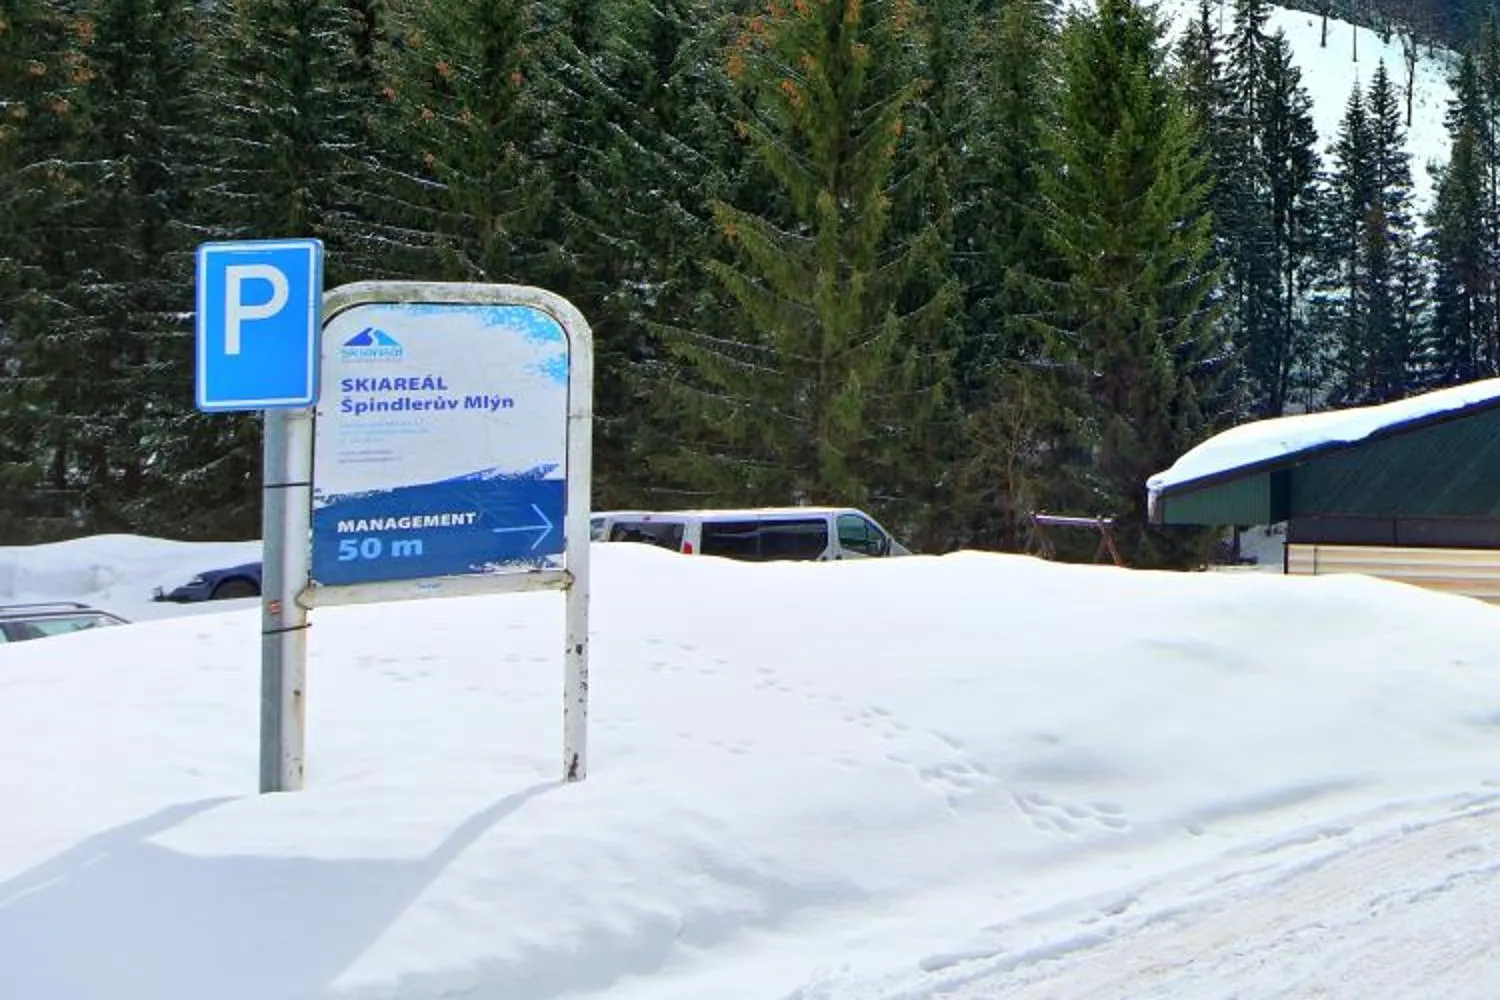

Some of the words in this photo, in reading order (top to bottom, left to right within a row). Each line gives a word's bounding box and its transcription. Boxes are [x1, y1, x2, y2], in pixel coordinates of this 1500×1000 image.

[224, 263, 290, 356] P
[340, 374, 449, 393] SKIAREÁL
[340, 395, 460, 416] Špindlerův
[463, 393, 516, 412] Mlýn
[337, 511, 477, 534] MANAGEMENT
[337, 537, 383, 562] 50
[391, 538, 423, 558] m
